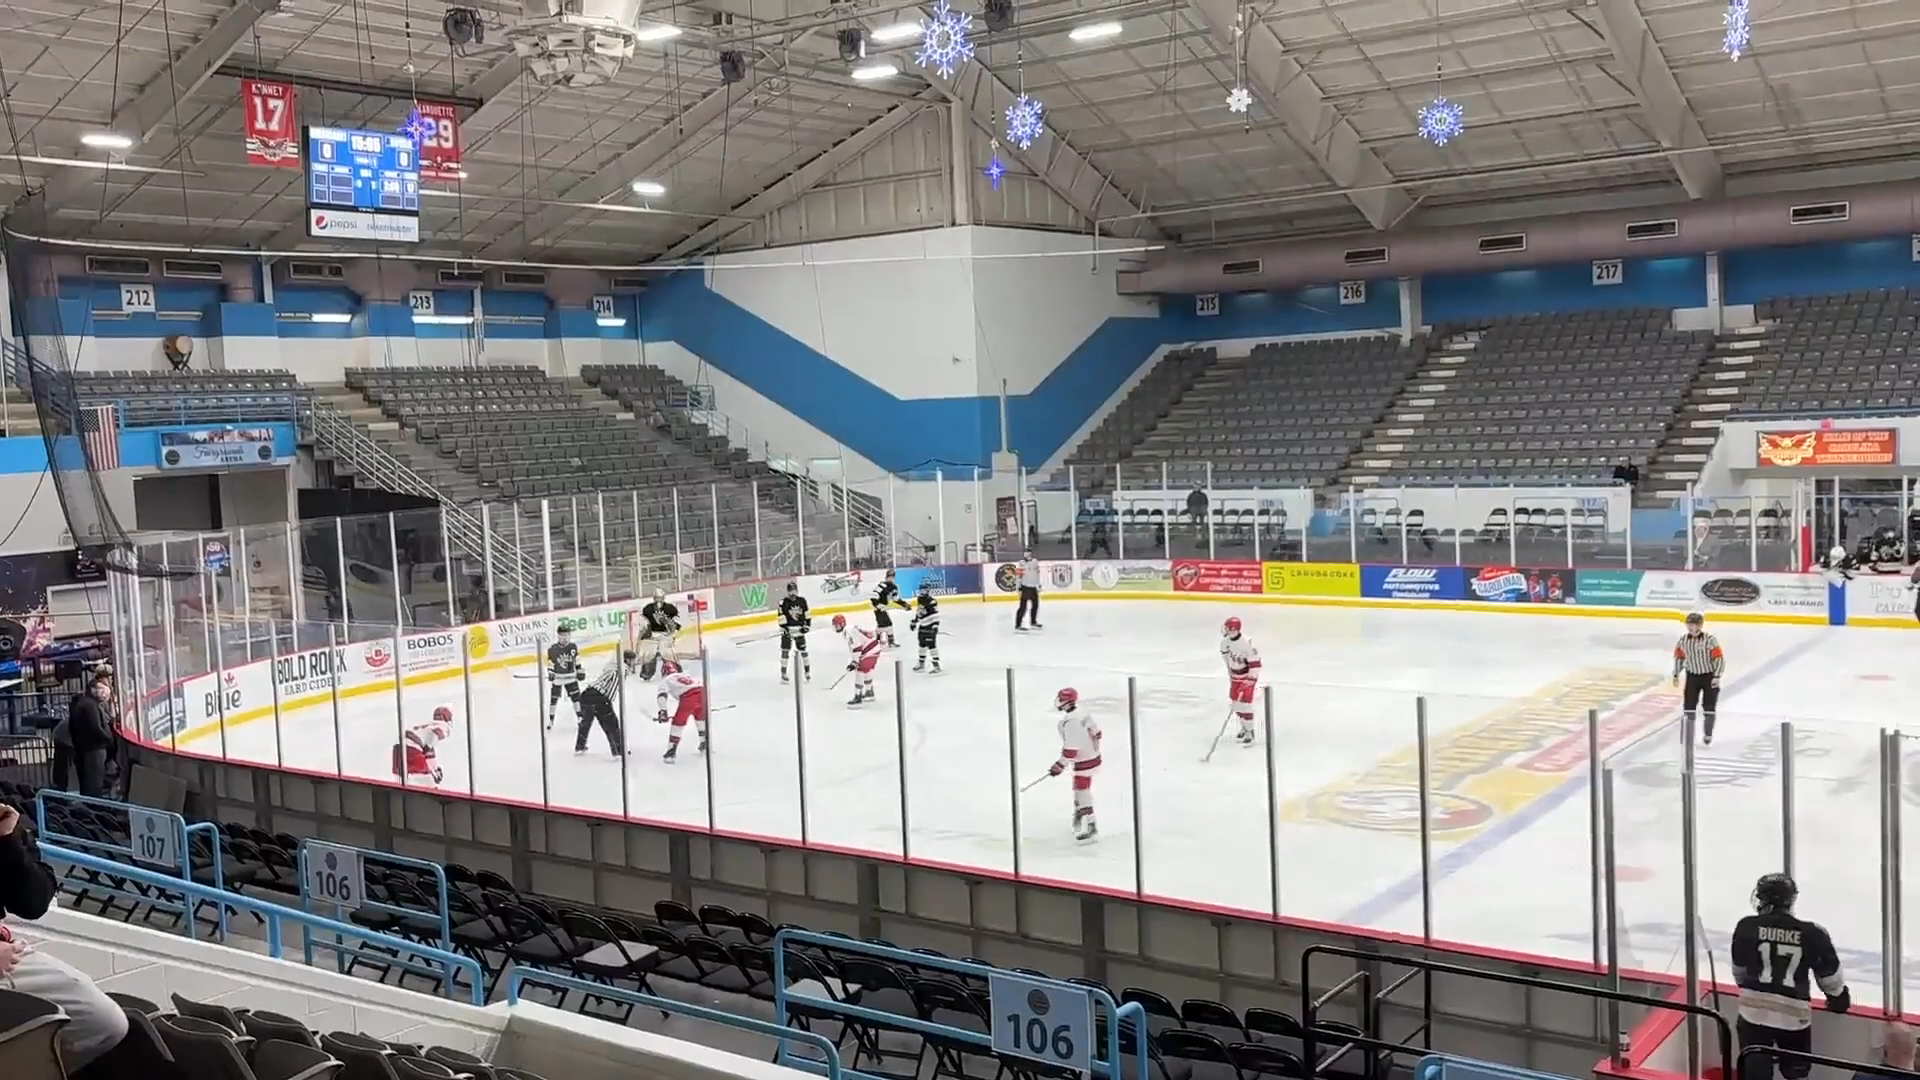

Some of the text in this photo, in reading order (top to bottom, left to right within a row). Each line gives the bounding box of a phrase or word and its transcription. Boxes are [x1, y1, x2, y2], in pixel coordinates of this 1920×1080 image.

[253, 96, 285, 131] 17
[422, 117, 454, 149] 29
[323, 143, 332, 159] 0
[399, 152, 409, 167] 0
[330, 219, 357, 231] pepsi
[1596, 264, 1617, 279] 217
[126, 290, 151, 306] 212
[1343, 287, 1362, 299] 216
[412, 295, 431, 309] 213
[597, 300, 611, 313] 214
[1198, 298, 1216, 311] 215
[1389, 568, 1438, 578] FLOW
[1382, 583, 1440, 591] AUTOMOTIVE
[557, 615, 588, 632] Tee
[607, 610, 627, 629] up
[407, 634, 454, 650] BOBOS
[277, 654, 307, 685] BOLD
[310, 647, 348, 679] ROCK
[309, 675, 343, 691] CIDER
[205, 689, 242, 718] Blue
[138, 834, 166, 859] 107
[315, 870, 351, 901] 106
[1758, 926, 1802, 944] BURKE
[1757, 942, 1803, 988] 17
[1007, 1014, 1074, 1060] 106
